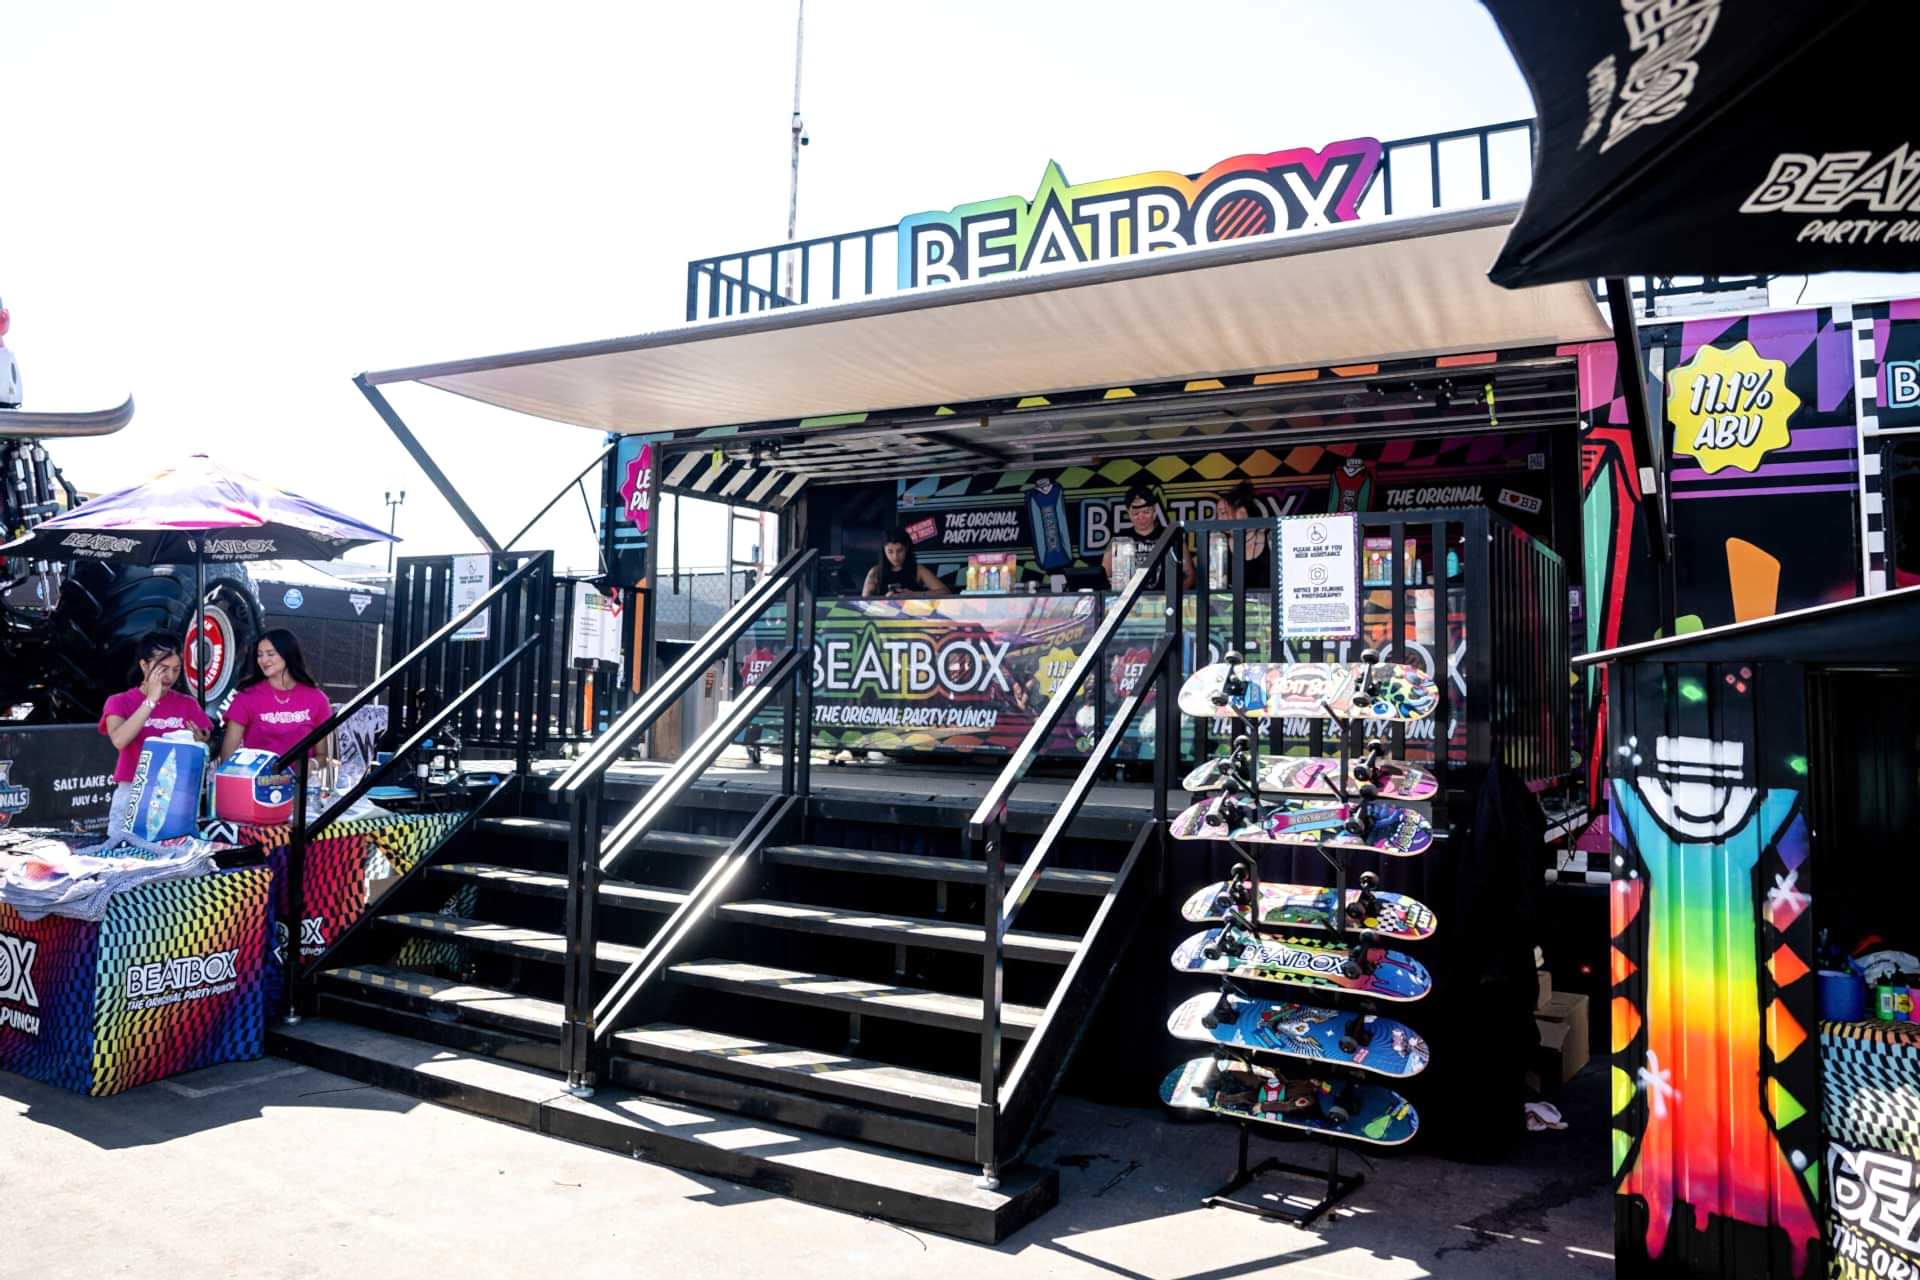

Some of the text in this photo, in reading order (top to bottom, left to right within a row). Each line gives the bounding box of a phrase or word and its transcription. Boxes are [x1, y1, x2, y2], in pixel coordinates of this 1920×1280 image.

[912, 152, 1362, 288] BEATBOX
[1796, 219, 1888, 244] PARTY
[1690, 369, 1773, 416] 11.1%
[636, 468, 651, 489] LE
[629, 490, 650, 511] PA
[1387, 485, 1485, 506] THE ORIGINAL
[944, 511, 1018, 528] THE ORIGINAL
[943, 529, 980, 545] PARTY
[979, 527, 1020, 544] PUNCH
[812, 640, 1011, 693] BEATBOX
[815, 705, 998, 728] THE ORIGINAL PARTY PUNCH
[53, 777, 78, 791] SALT
[79, 775, 105, 789] LAKE
[71, 795, 90, 807] JULY
[91, 794, 98, 803] 4
[104, 792, 112, 802] 5
[1241, 944, 1351, 975] BEATBOX
[126, 948, 239, 998] BEATBOX
[127, 999, 146, 1011] THE
[144, 992, 182, 1009] ORIGINAL
[183, 987, 211, 1001] PARTY
